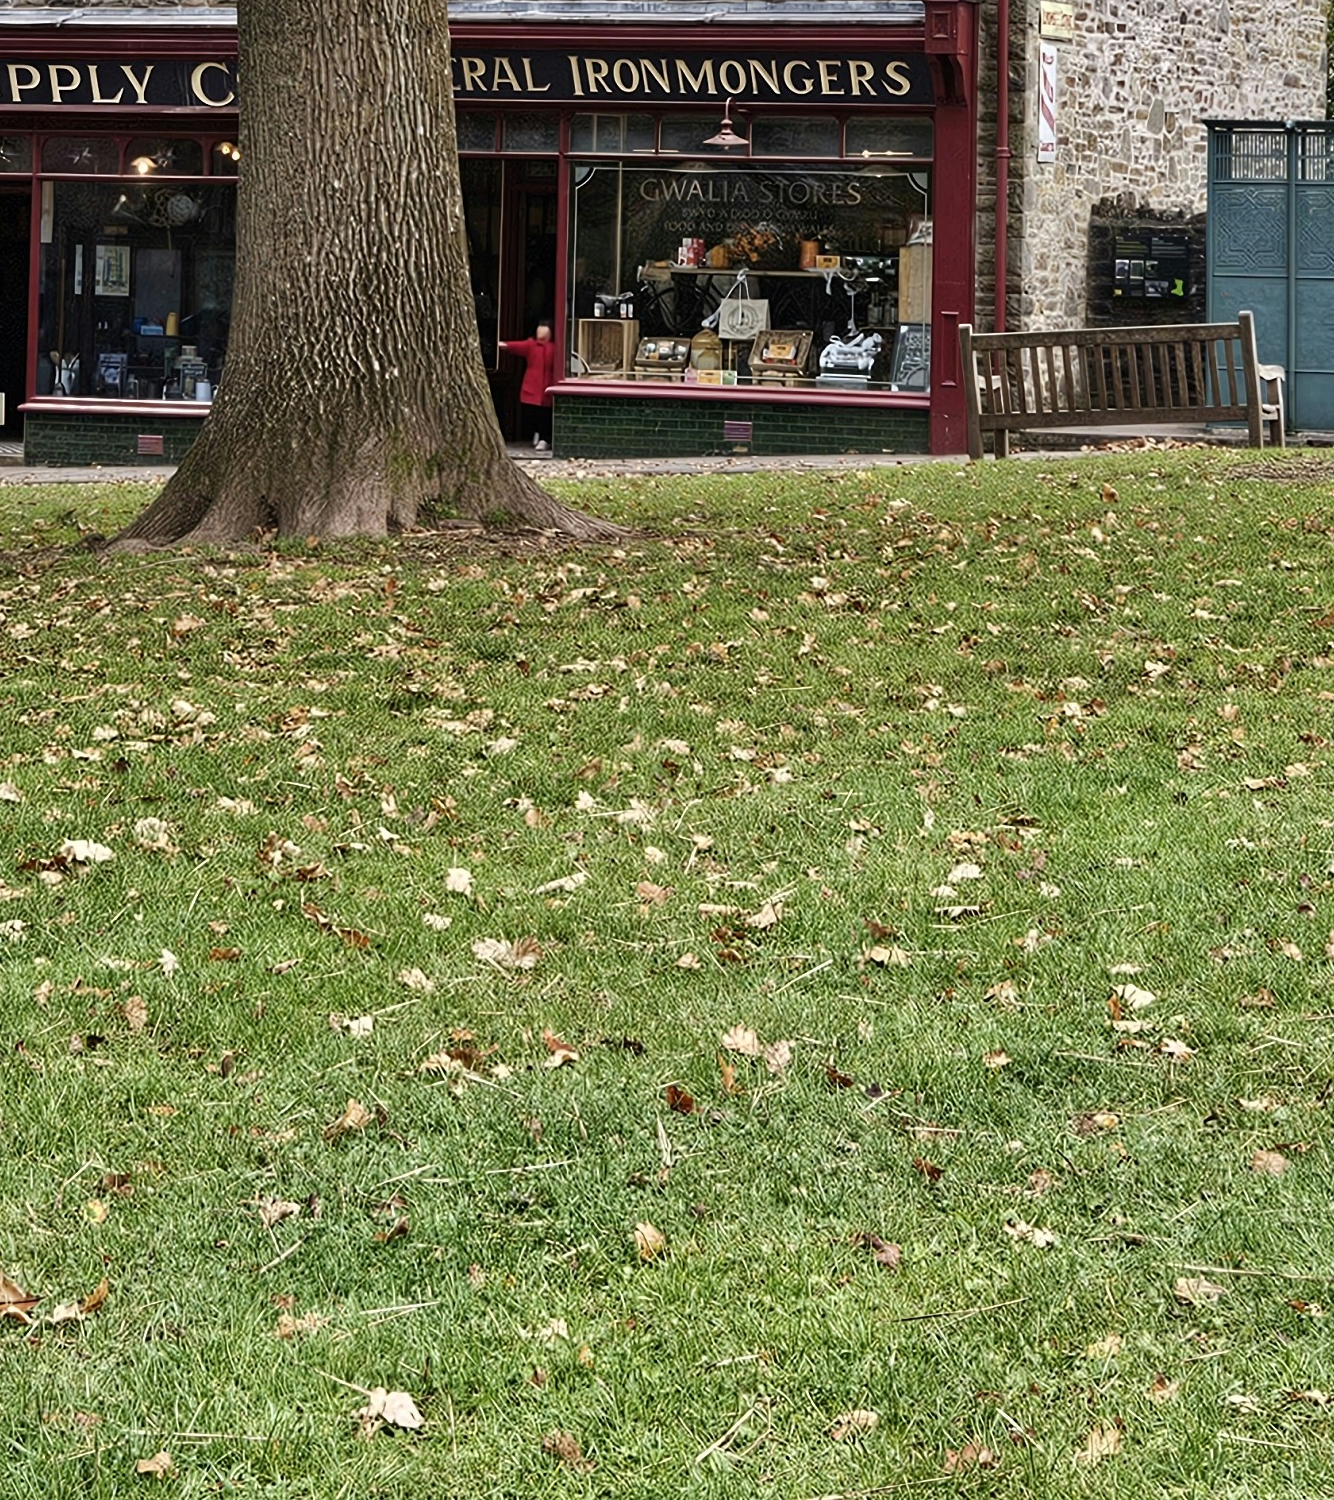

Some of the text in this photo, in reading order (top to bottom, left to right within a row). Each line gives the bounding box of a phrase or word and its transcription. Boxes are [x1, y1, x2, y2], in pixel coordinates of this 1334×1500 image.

[191, 62, 238, 107] C
[567, 55, 912, 96] IRONMONGERS
[640, 179, 862, 205] GWALIA STORES
